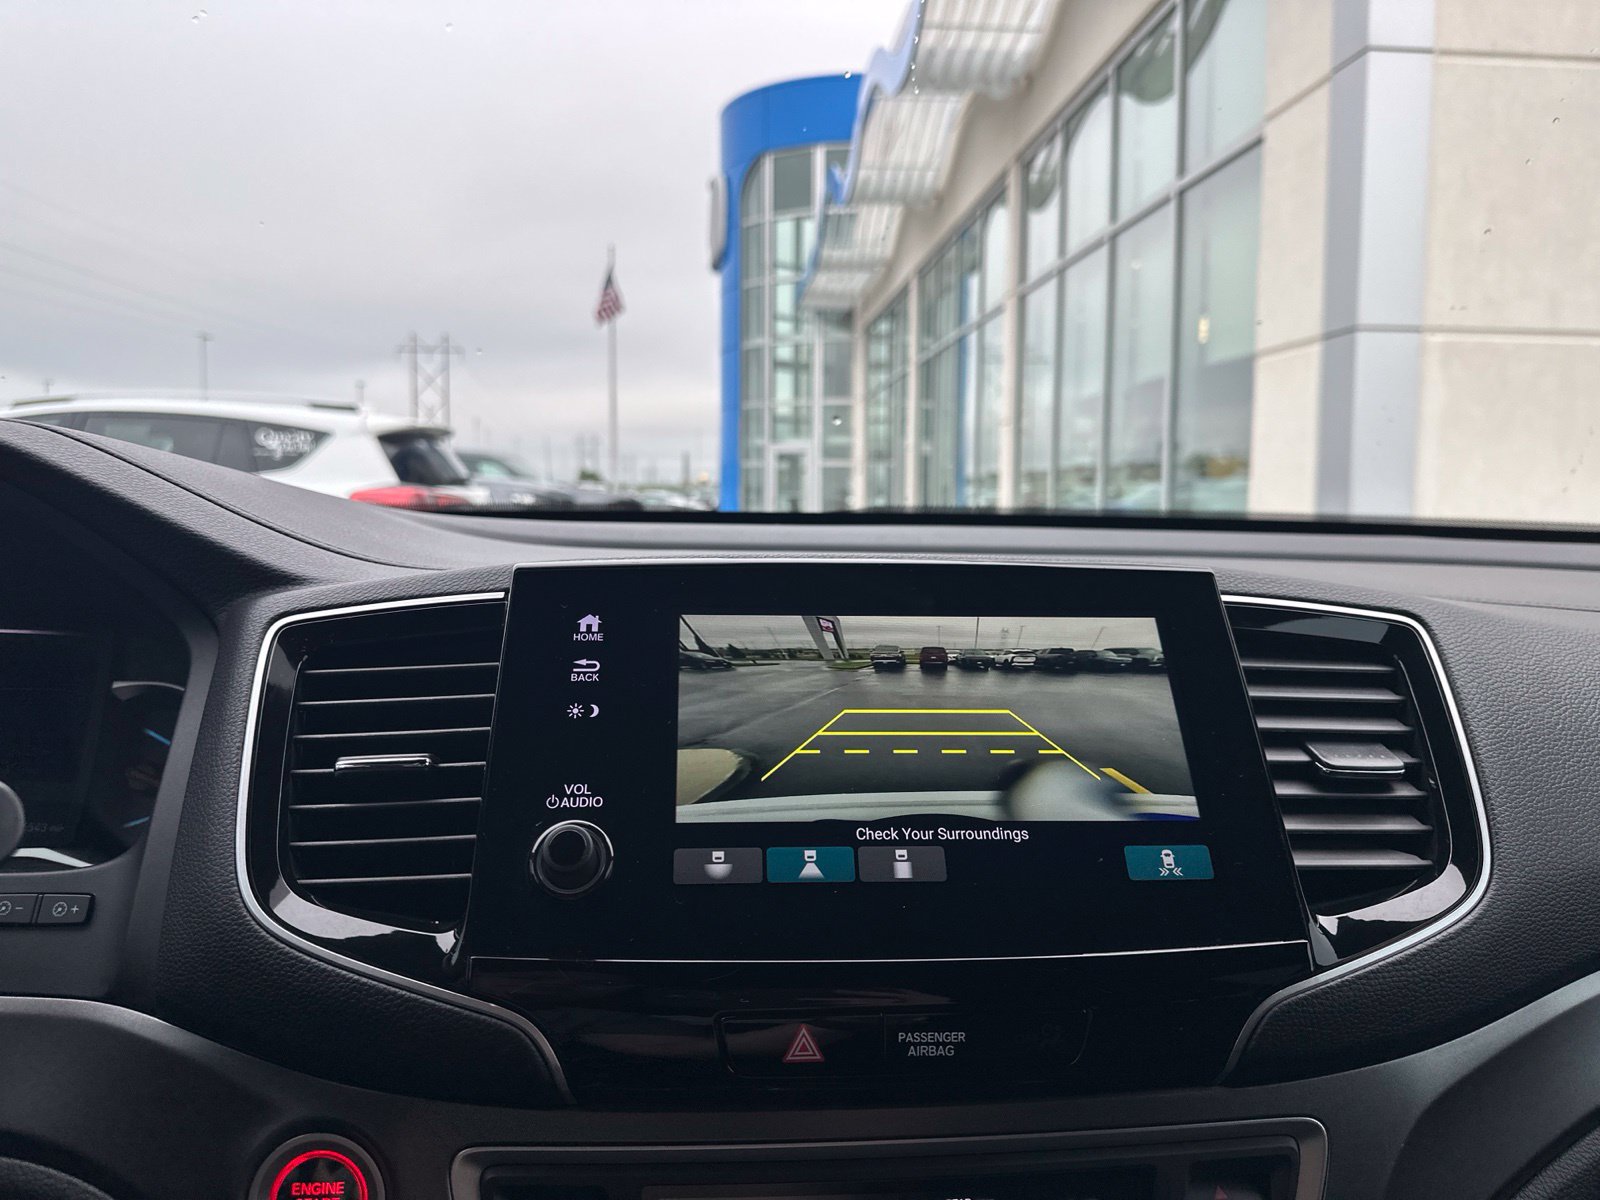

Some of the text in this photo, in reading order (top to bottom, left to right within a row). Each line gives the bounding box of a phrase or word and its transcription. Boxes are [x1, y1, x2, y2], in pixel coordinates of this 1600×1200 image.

[573, 633, 604, 641] HOME
[570, 673, 600, 682] BACK
[564, 783, 592, 795] VOL
[560, 796, 604, 808] AUDIO
[855, 827, 1030, 843] Check Your Surroundings
[898, 1032, 966, 1043] PASSENGER
[907, 1045, 955, 1057] AIRBAG
[291, 1181, 345, 1195] ENGINE
